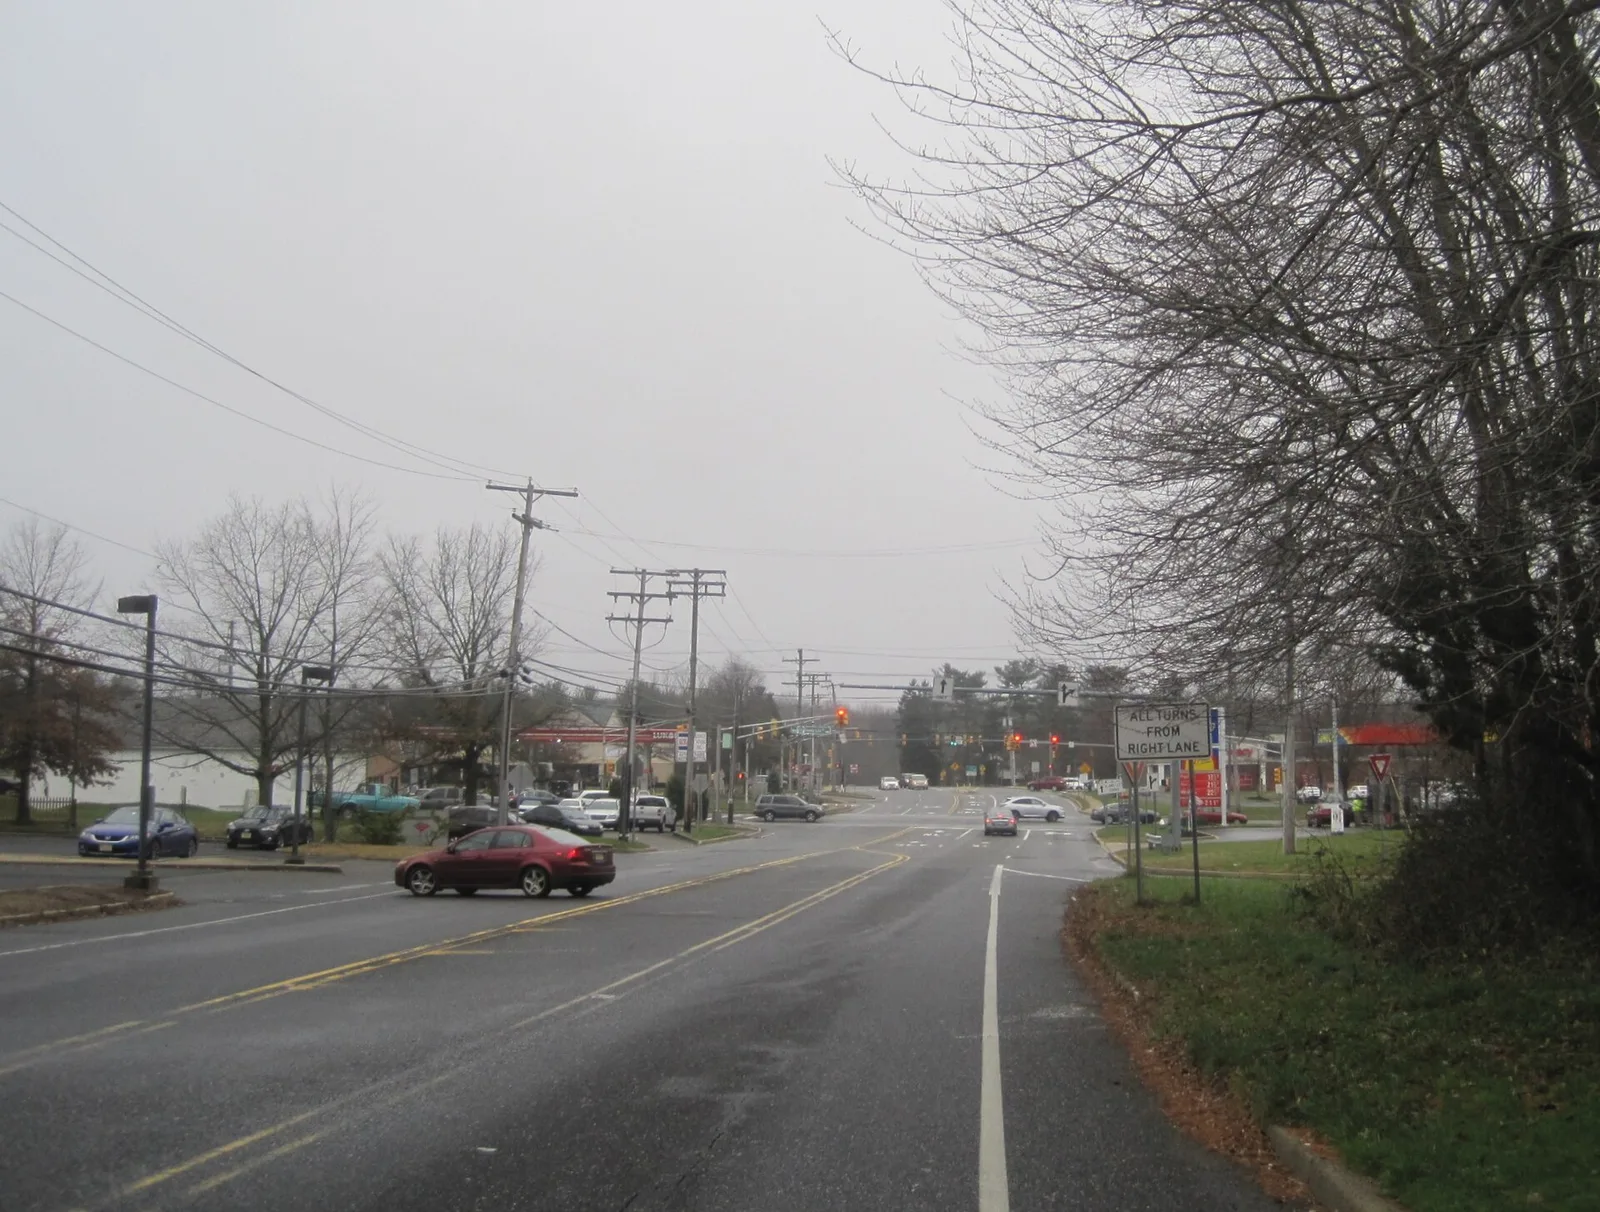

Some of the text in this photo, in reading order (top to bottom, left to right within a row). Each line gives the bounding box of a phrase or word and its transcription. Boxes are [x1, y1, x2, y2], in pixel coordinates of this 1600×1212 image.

[1130, 709, 1198, 721] ALL TURNS
[1147, 726, 1181, 737] FROM
[1128, 741, 1200, 754] RIGHT LANE
